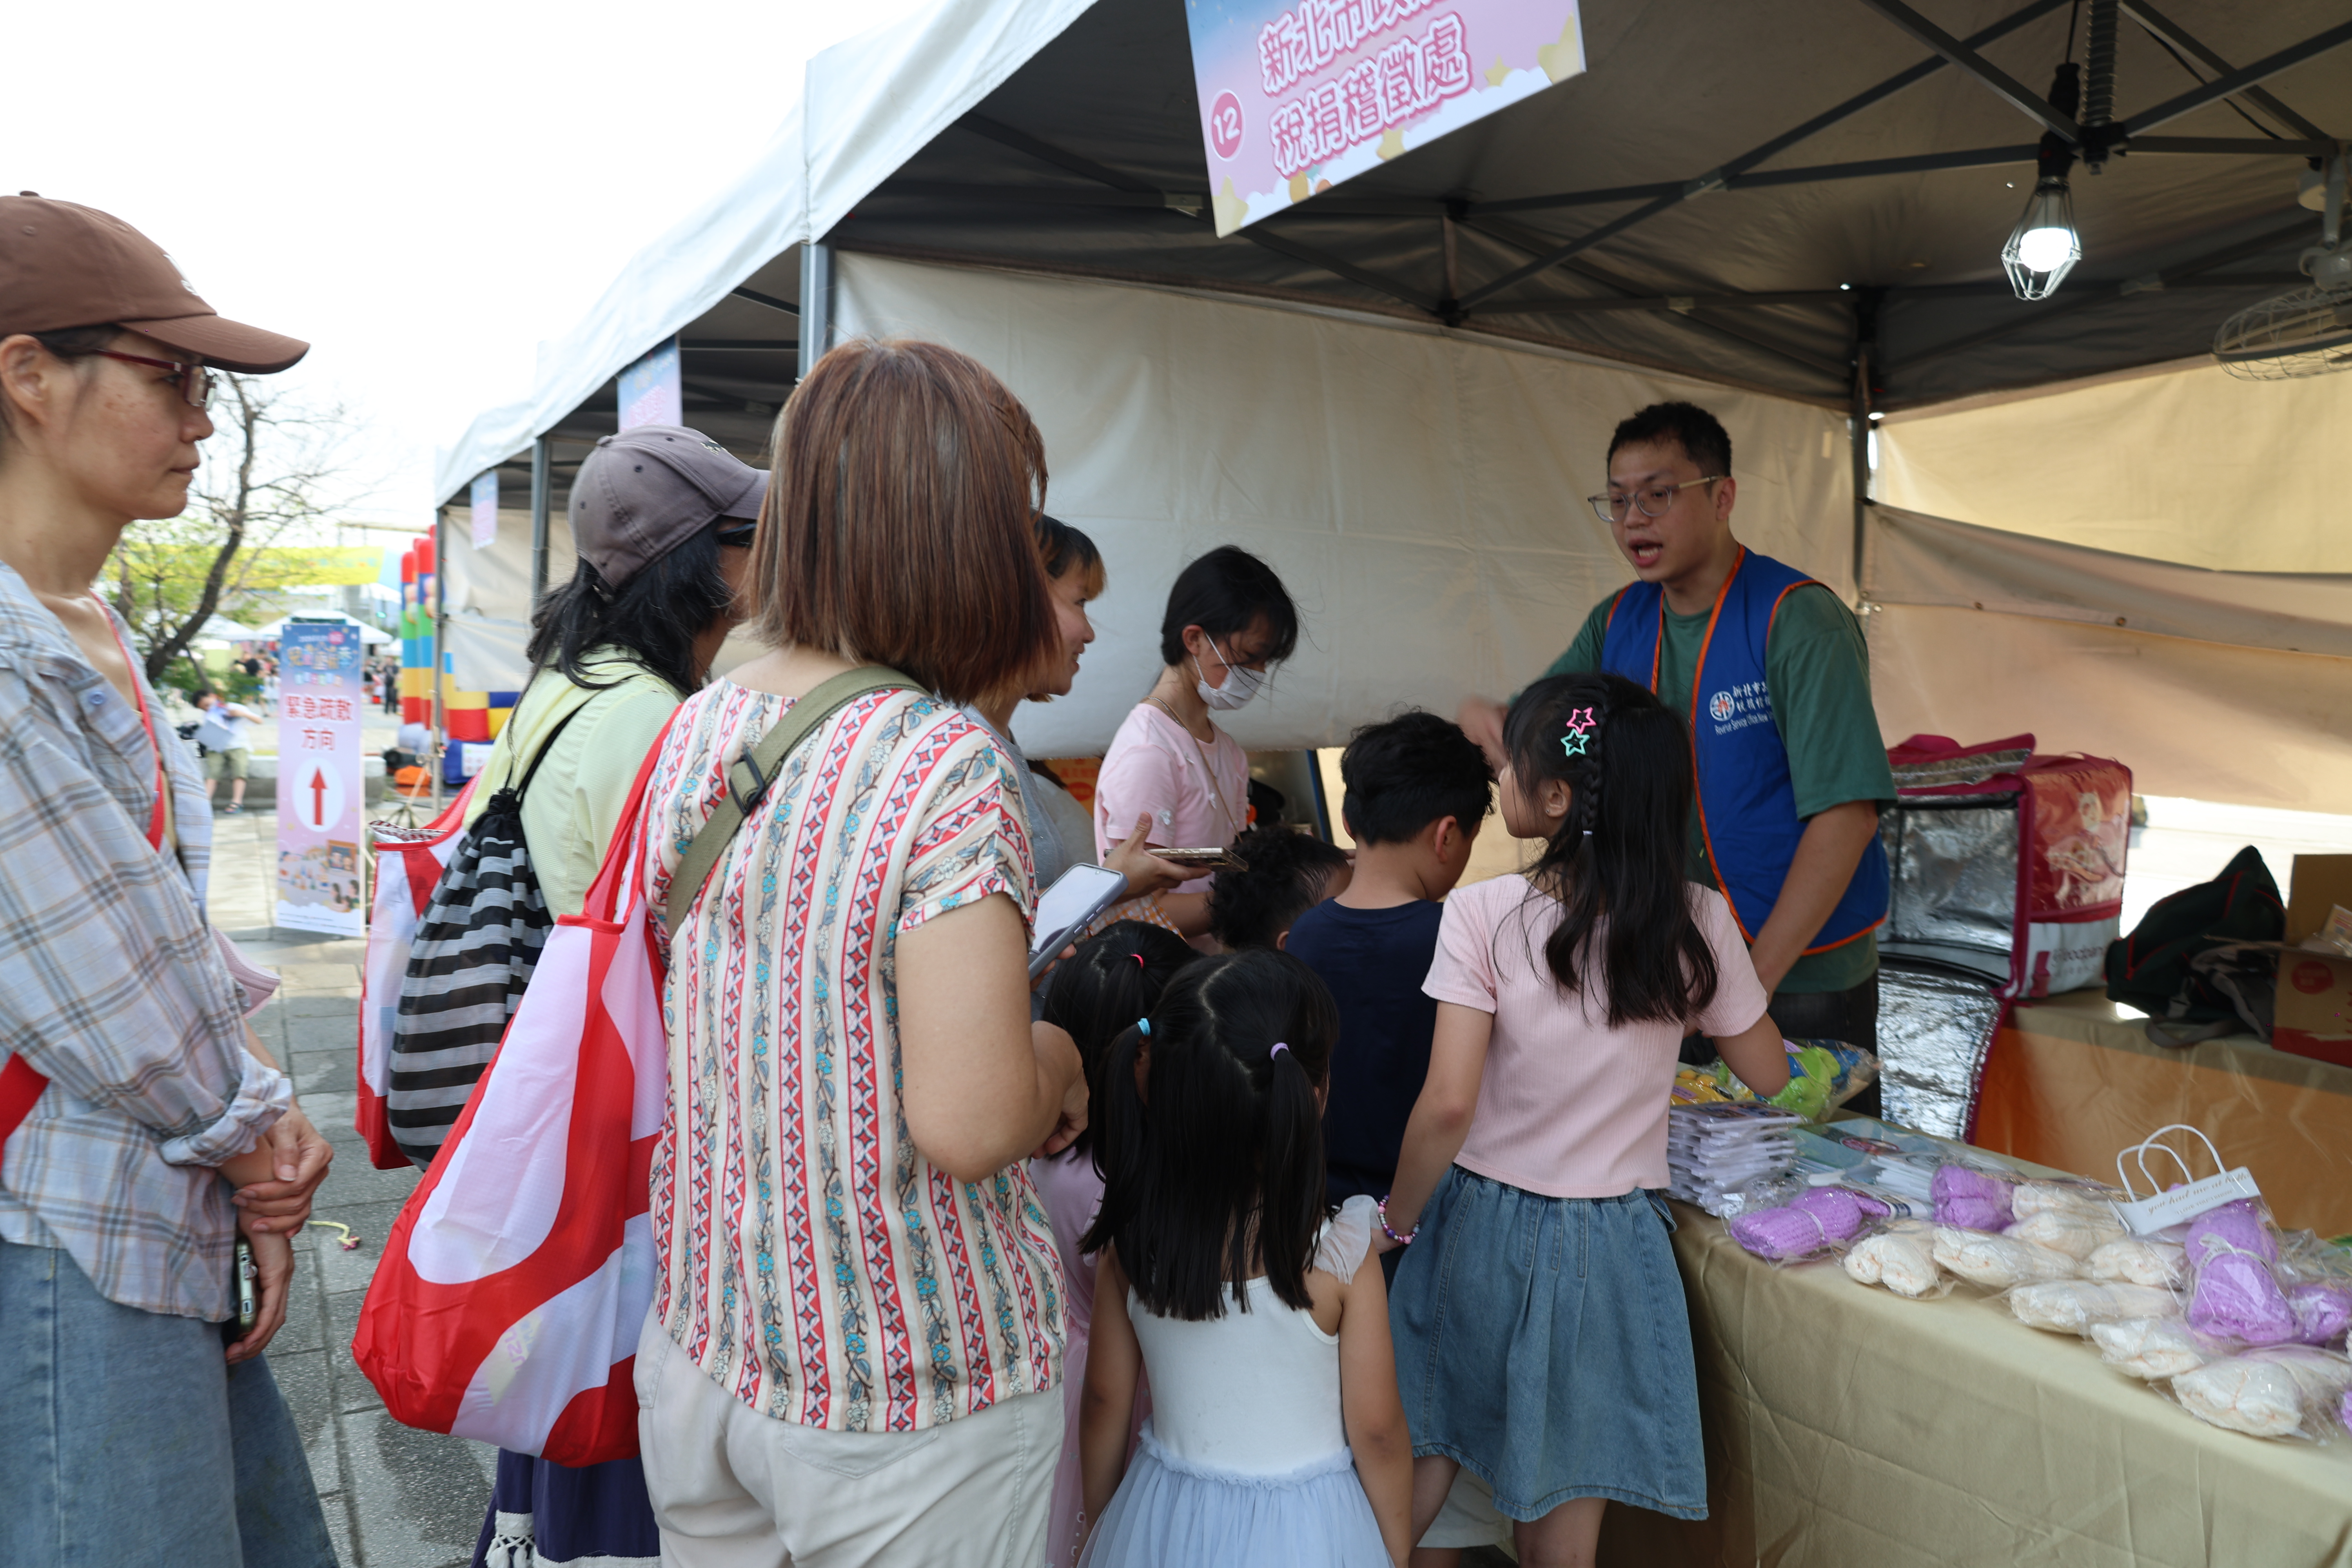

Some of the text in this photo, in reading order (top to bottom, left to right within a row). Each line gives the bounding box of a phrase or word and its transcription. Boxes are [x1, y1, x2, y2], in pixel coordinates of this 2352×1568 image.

[1258, 0, 1438, 95] 新北市
[1213, 106, 1240, 145] 12
[287, 695, 352, 720] 緊急疏散
[301, 728, 334, 751] 方向
